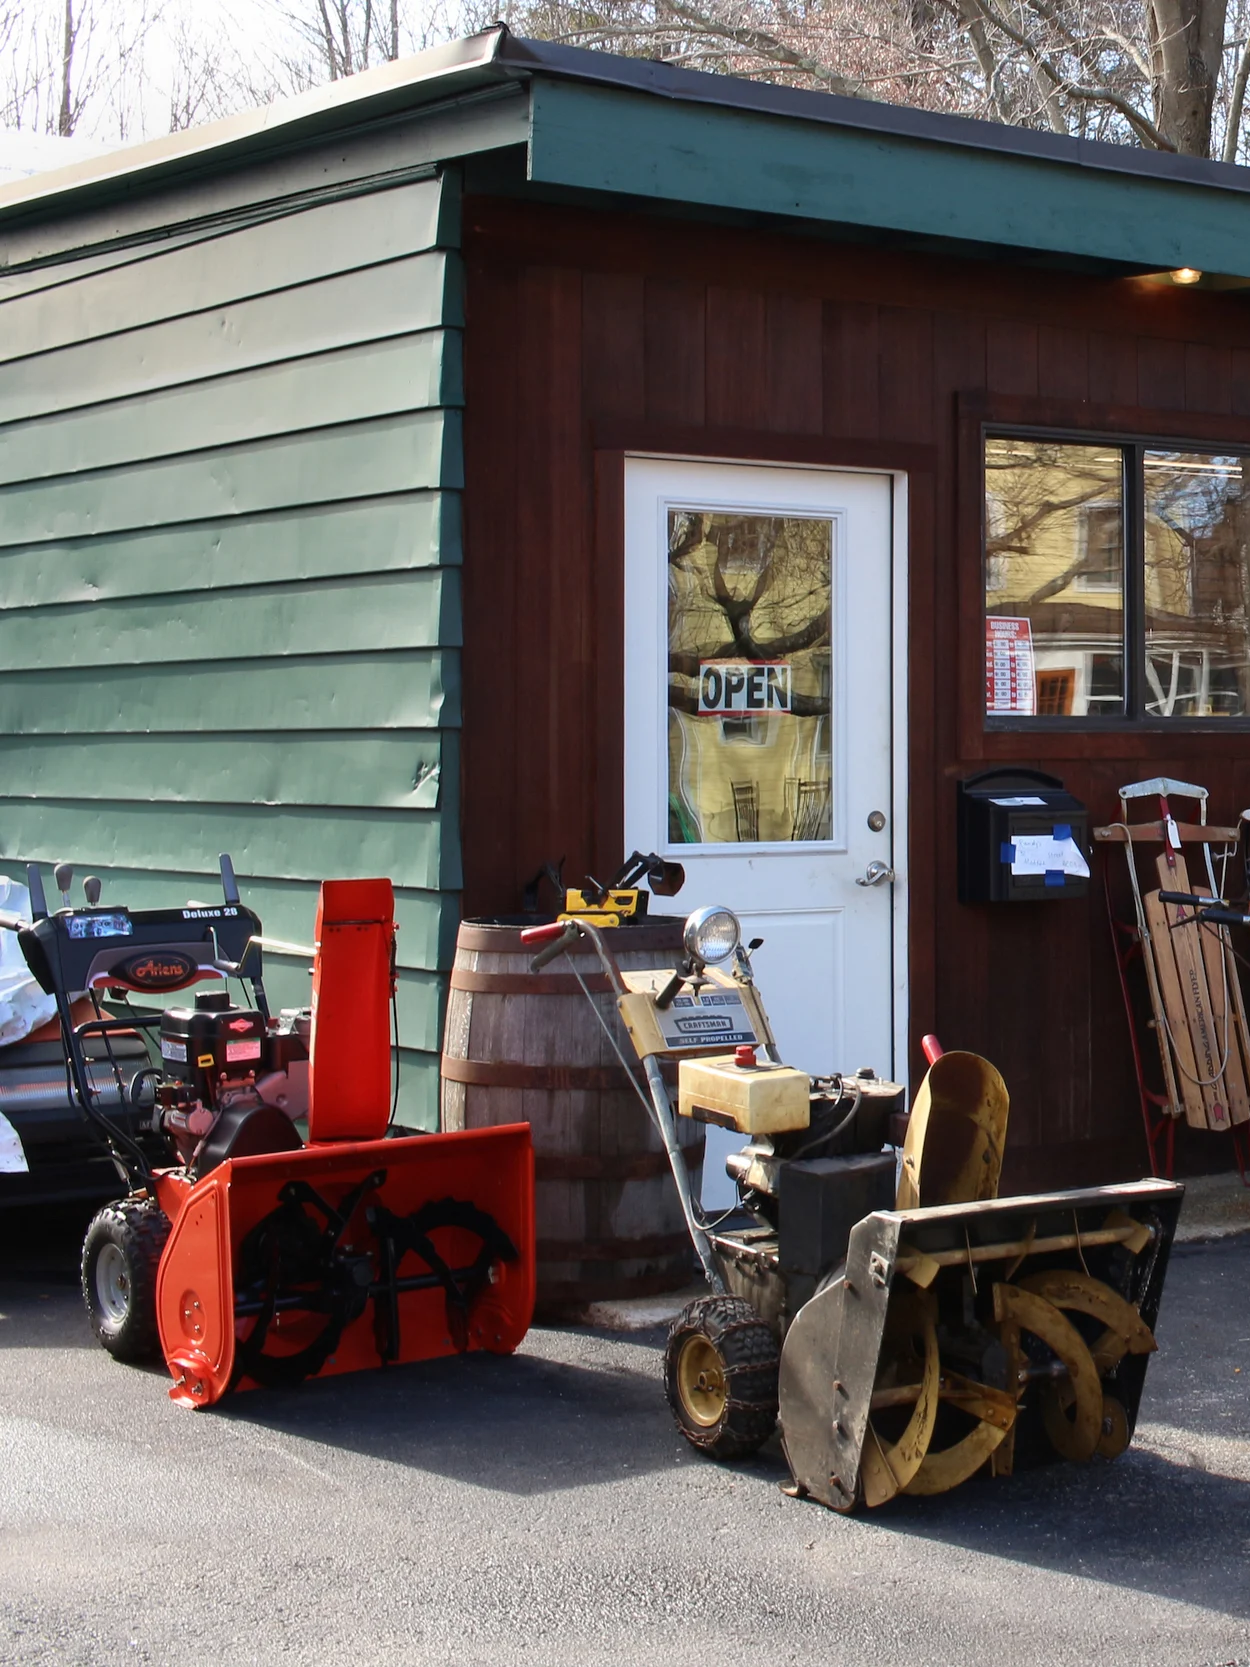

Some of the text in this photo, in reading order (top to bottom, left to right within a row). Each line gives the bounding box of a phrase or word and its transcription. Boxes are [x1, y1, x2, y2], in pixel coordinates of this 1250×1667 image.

[701, 666, 788, 709] OPEN
[182, 909, 221, 919] Deluxe
[136, 961, 184, 978] Ariens
[683, 1020, 727, 1030] CRAFTSMAN
[680, 1034, 743, 1044] SELF PROPELLED
